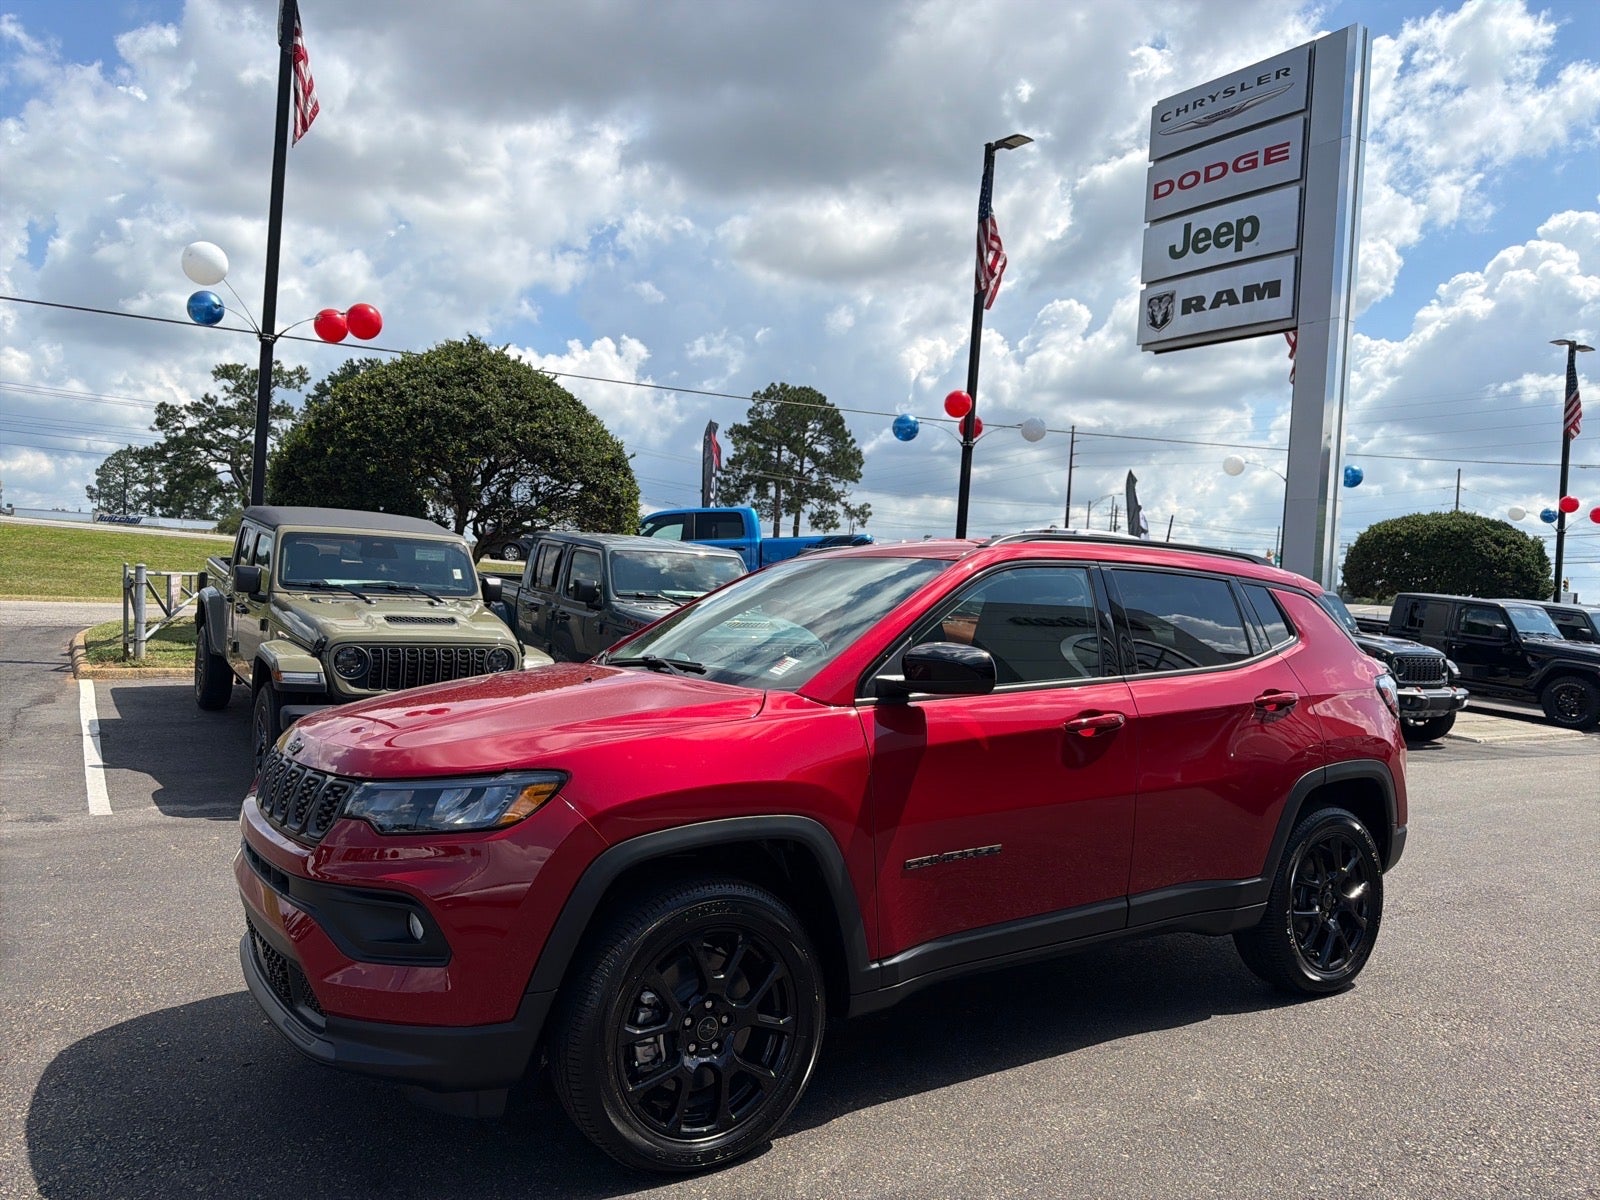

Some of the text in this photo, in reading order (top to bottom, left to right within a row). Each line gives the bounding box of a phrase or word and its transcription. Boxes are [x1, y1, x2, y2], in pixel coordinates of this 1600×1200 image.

[1160, 67, 1291, 123] CHRYSLER
[1153, 141, 1291, 200] DODGE
[1168, 214, 1261, 260] Jeep
[1181, 279, 1281, 316] RAM
